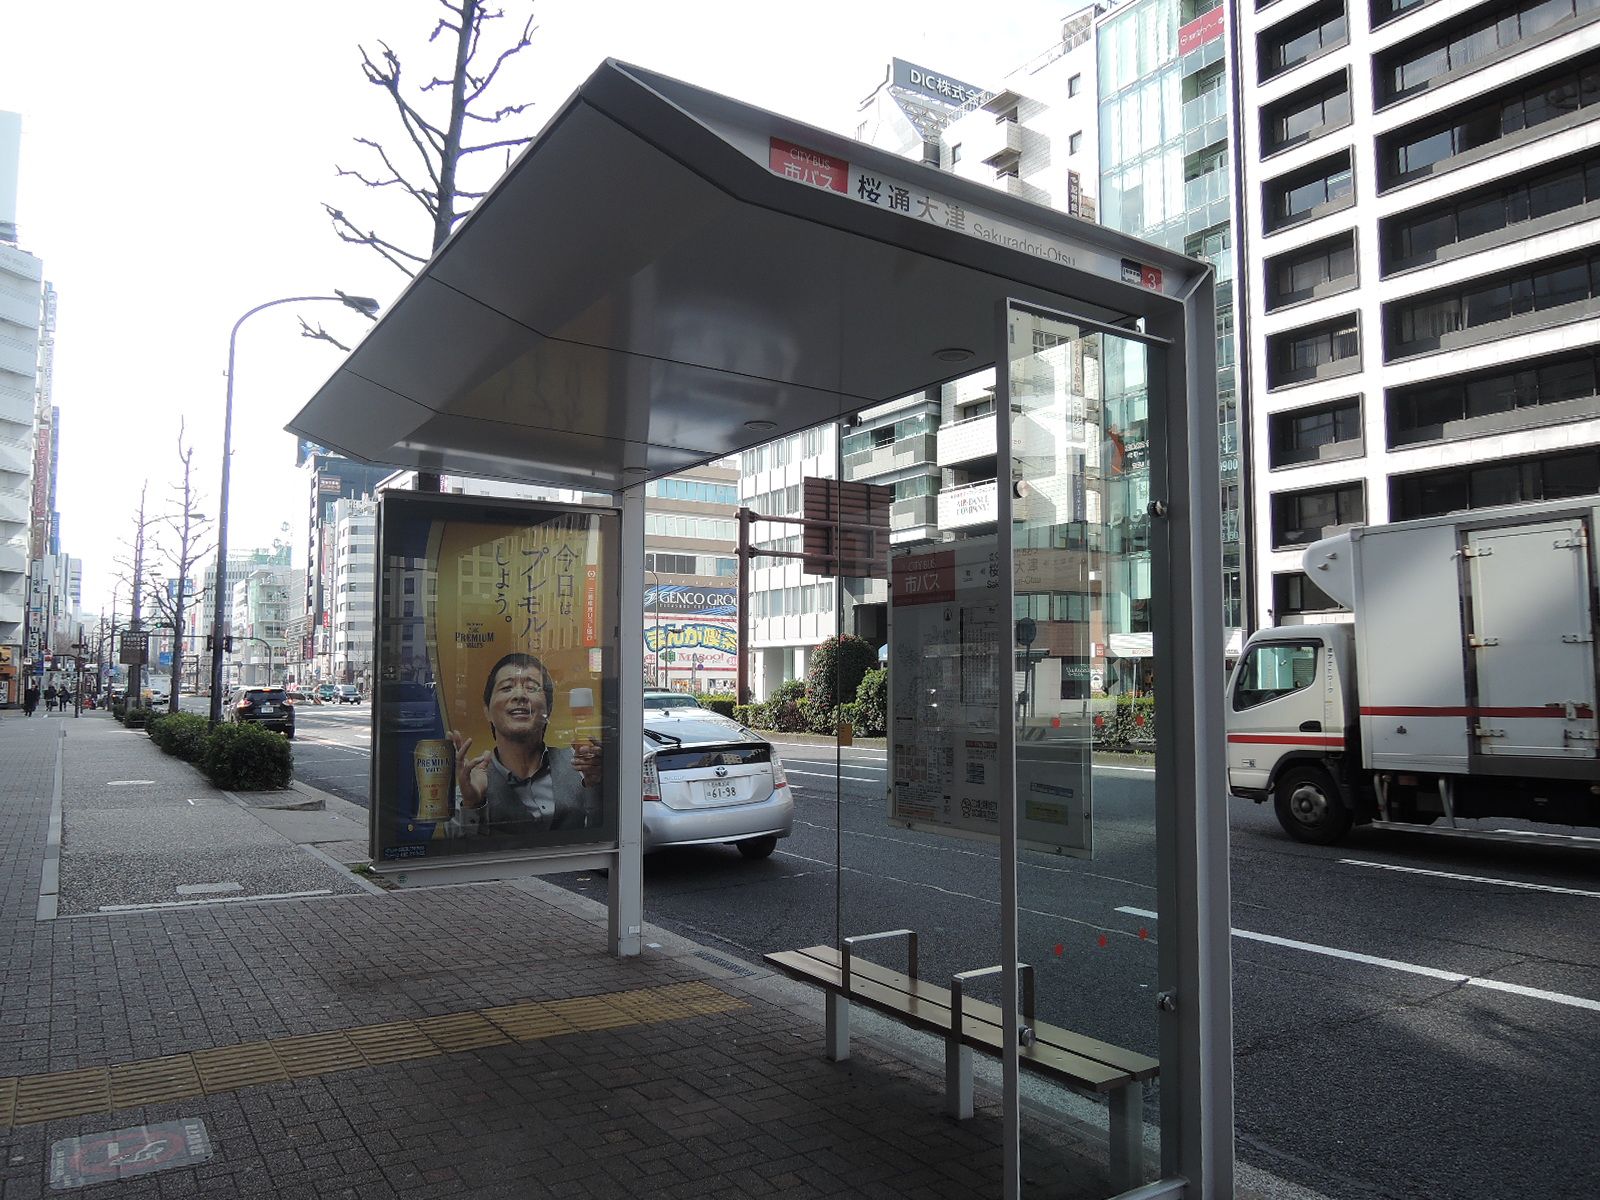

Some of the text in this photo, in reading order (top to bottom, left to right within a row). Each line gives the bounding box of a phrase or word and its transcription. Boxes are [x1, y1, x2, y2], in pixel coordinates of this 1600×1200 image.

[790, 148, 831, 170] CITY BUS
[784, 162, 833, 190] 市バス
[858, 174, 966, 230] 桜通大津
[973, 223, 1075, 267] Sakuradori-Otsu
[1147, 272, 1157, 290] 3
[495, 544, 513, 623] しよう。
[904, 573, 941, 593] 市バス
[659, 591, 705, 605] GENCO
[455, 631, 494, 643] PREMIUM
